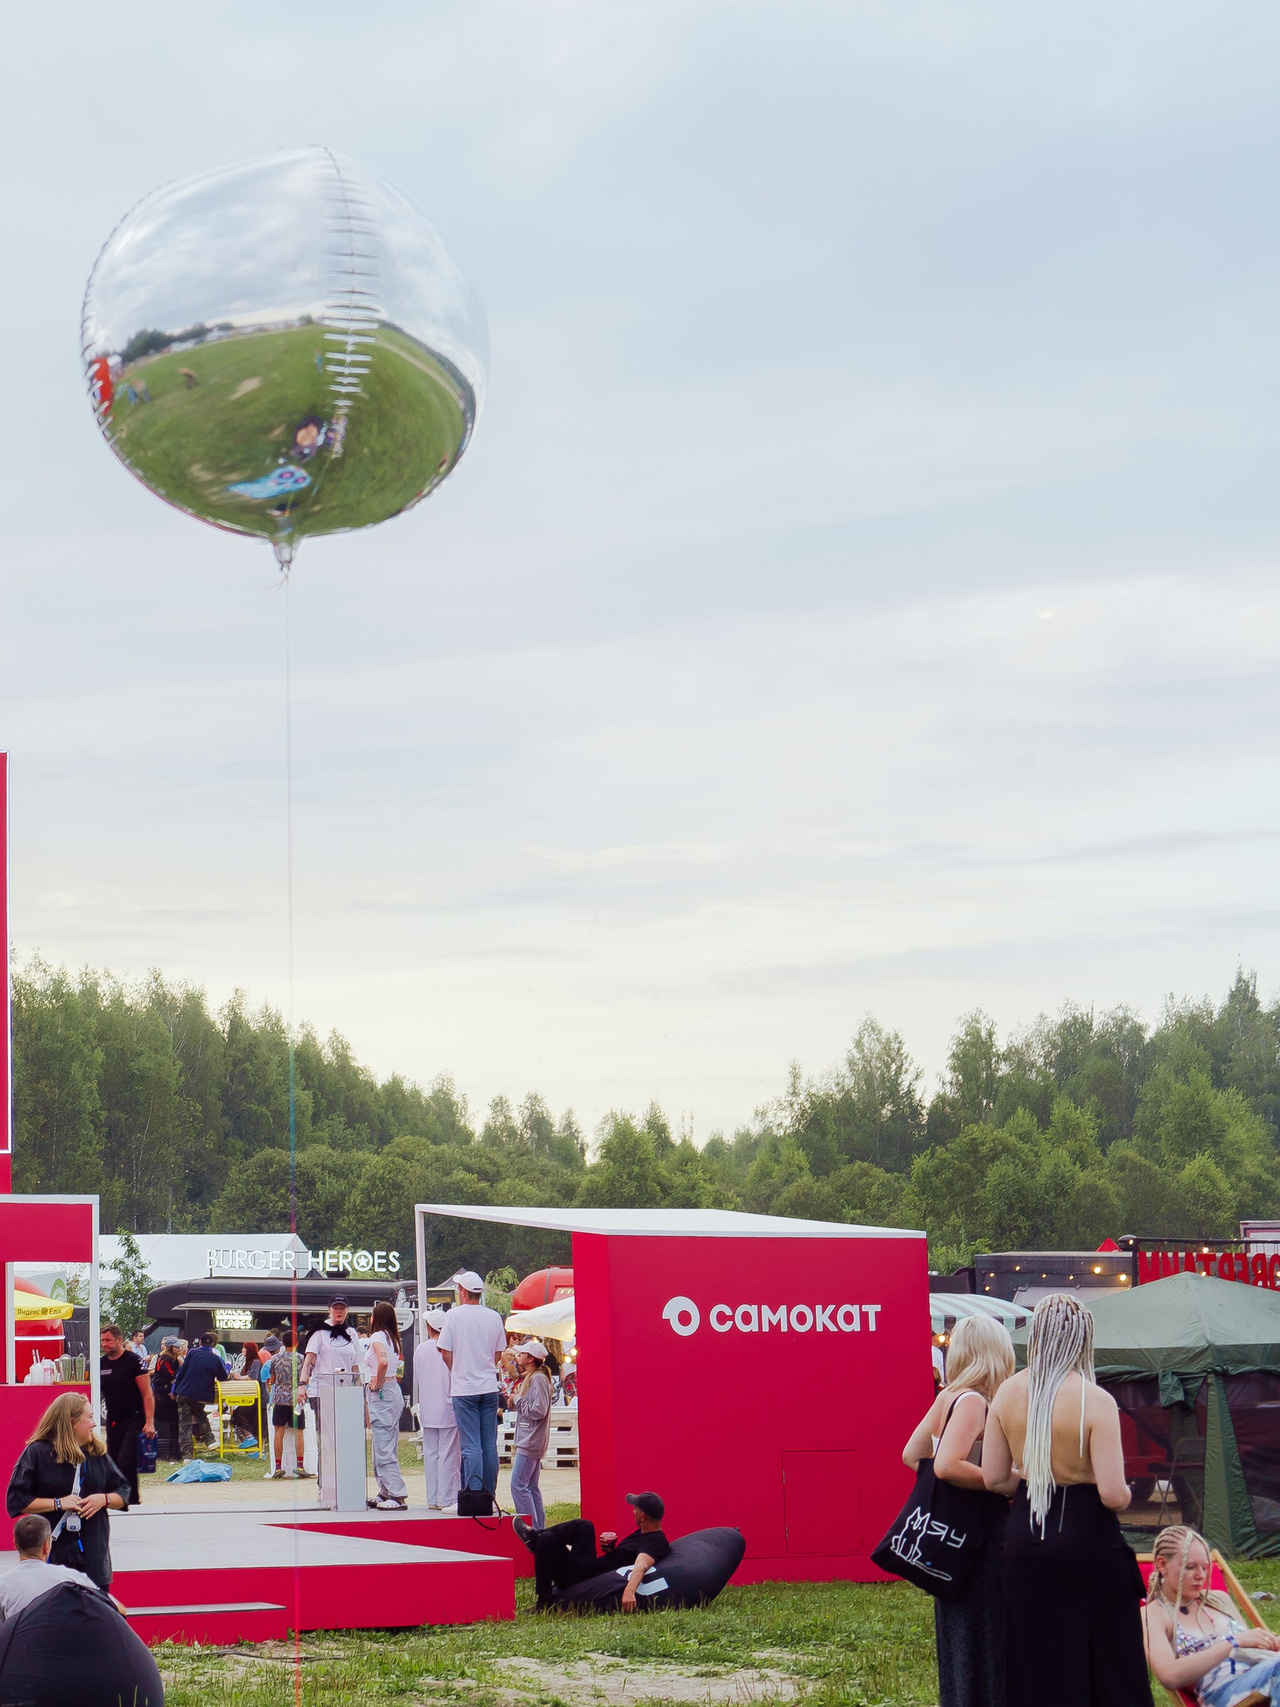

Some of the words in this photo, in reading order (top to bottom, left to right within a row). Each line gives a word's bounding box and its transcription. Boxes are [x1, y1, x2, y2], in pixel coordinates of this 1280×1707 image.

[206, 1250, 296, 1270] BURGER
[308, 1250, 400, 1272] HEROES
[17, 1308, 40, 1316] Яндекс
[216, 1319, 252, 1329] HEROES
